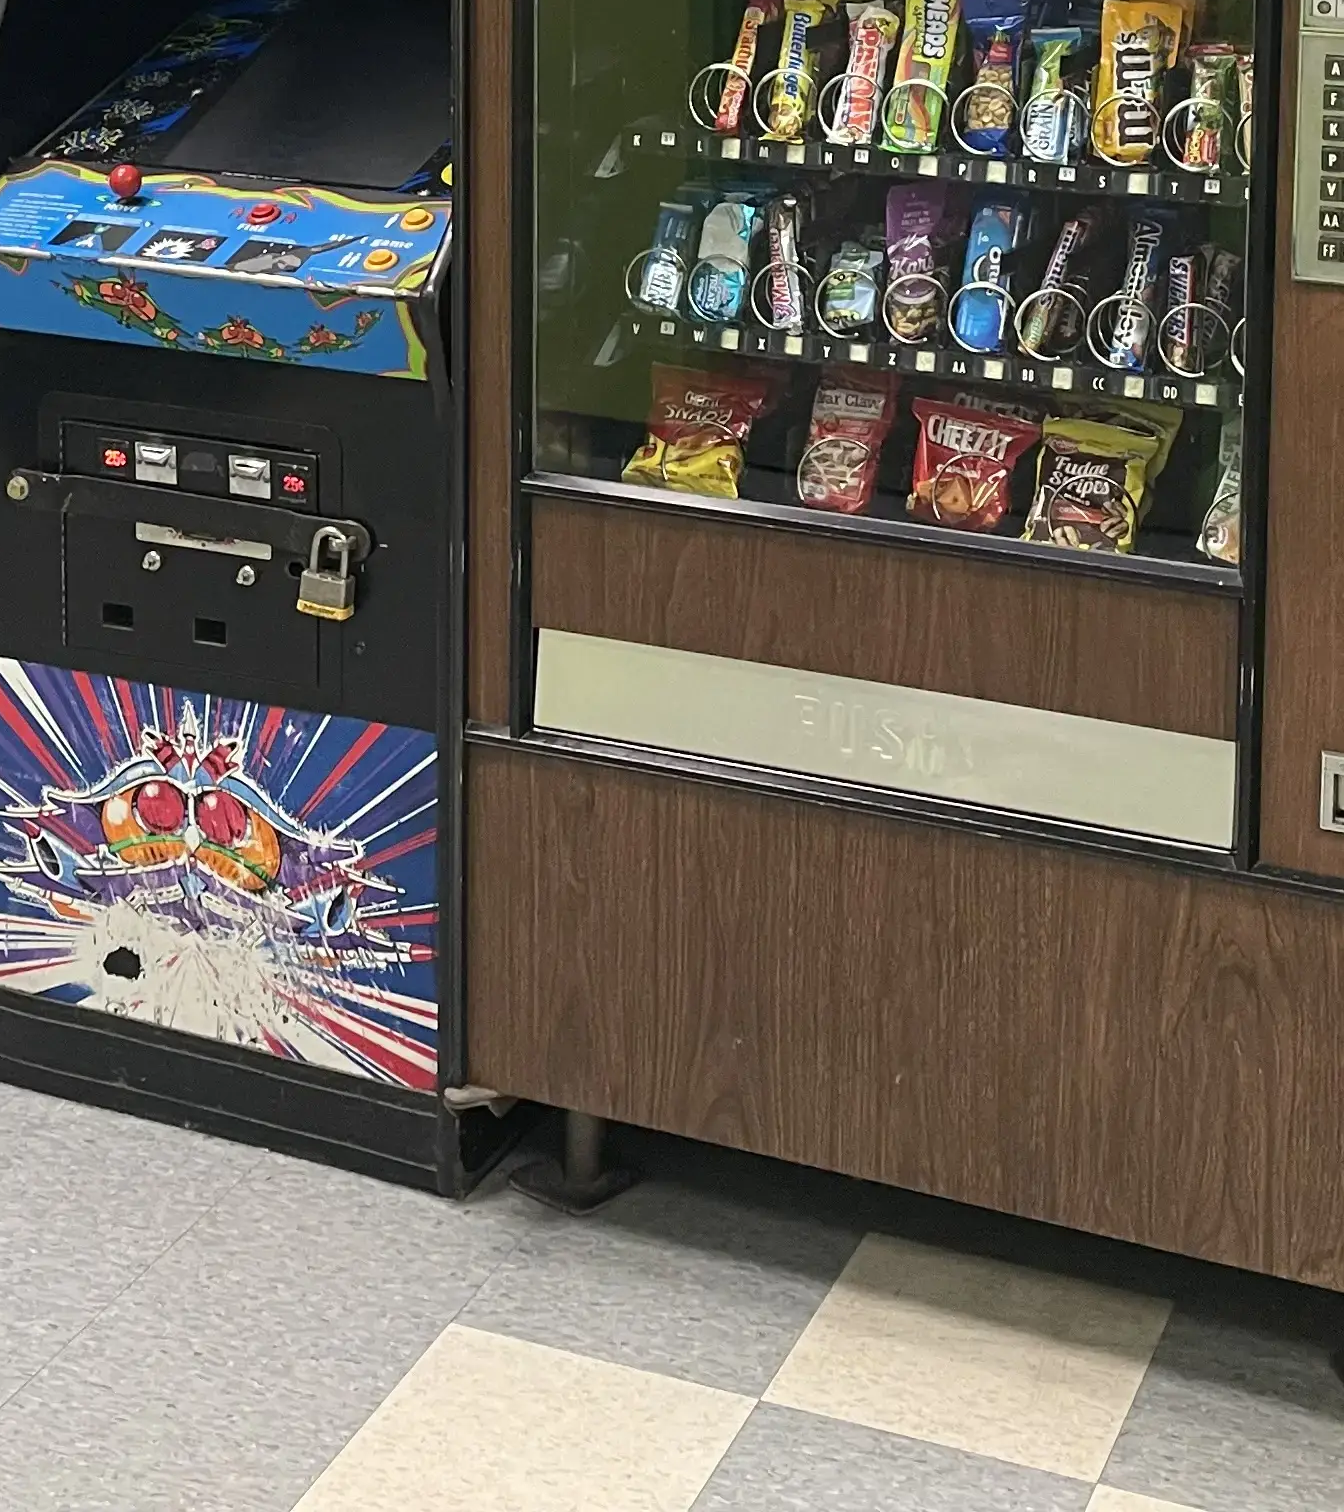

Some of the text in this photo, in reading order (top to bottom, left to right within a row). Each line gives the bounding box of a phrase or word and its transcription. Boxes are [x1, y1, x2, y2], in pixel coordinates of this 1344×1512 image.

[783, 12, 812, 99] Butterfiger
[1331, 62, 1341, 76] A
[1330, 92, 1337, 106] F
[1038, 103, 1054, 150] GRAIN
[1329, 123, 1338, 137] K
[633, 135, 641, 147] K
[696, 140, 702, 152] L
[758, 146, 769, 158] M
[824, 152, 833, 164] N
[891, 156, 899, 169] O
[1329, 153, 1337, 167] P
[958, 163, 967, 176] P
[1028, 169, 1037, 183] R
[1098, 175, 1106, 188] S
[1171, 181, 1179, 194] T
[1327, 183, 1336, 196] V
[1323, 214, 1339, 227] AA
[369, 237, 414, 249] game
[1323, 244, 1336, 258] FF
[987, 246, 1003, 296] ORO
[1167, 256, 1191, 347] SNICKERS
[632, 323, 641, 335] V
[693, 329, 705, 342] W
[757, 338, 766, 351] X
[823, 346, 832, 358] Y
[888, 352, 896, 365] Z
[952, 361, 967, 374] AA
[1022, 368, 1035, 382] BB
[1092, 376, 1105, 390] CC
[1163, 385, 1178, 399] DD
[844, 394, 881, 410] Claw
[1055, 456, 1110, 475] Fudge
